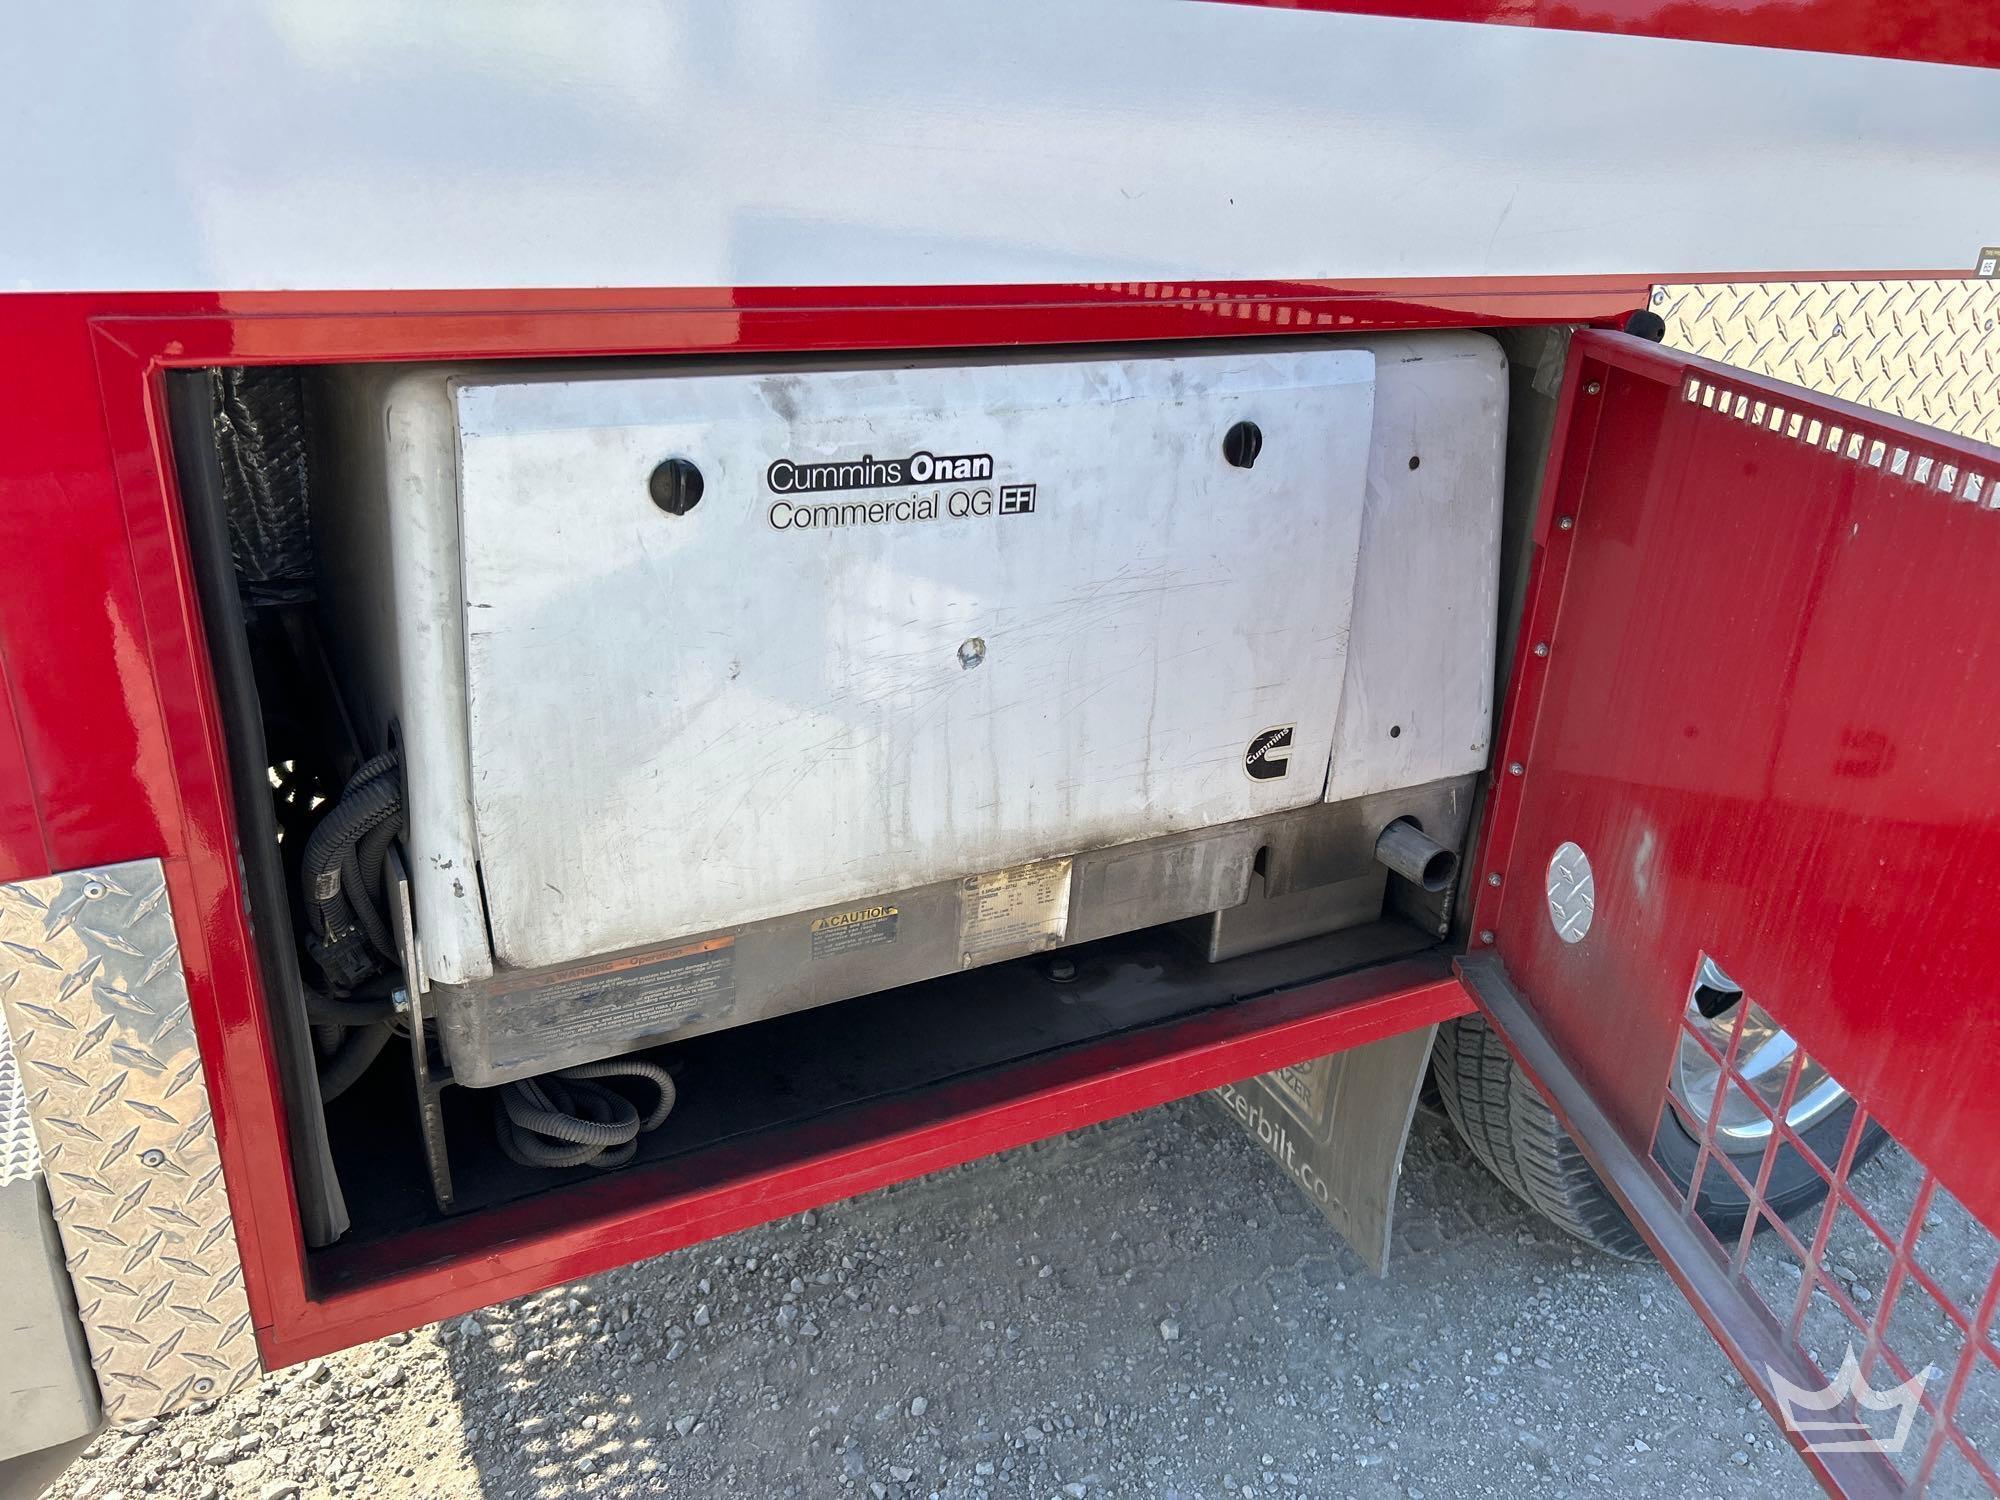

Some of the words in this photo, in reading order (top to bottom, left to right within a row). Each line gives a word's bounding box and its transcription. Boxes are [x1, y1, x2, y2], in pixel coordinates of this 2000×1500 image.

[771, 456, 901, 491] Cummins
[910, 454, 991, 482] Onan
[770, 493, 939, 530] Commercial
[948, 490, 993, 517] QG
[1001, 486, 1035, 514] EFI
[1246, 727, 1290, 765] Cummins
[830, 906, 890, 927] CAUTION
[556, 963, 614, 979] WARNING
[630, 949, 682, 966] Operation
[1213, 1084, 1346, 1218] zerbilt.co
